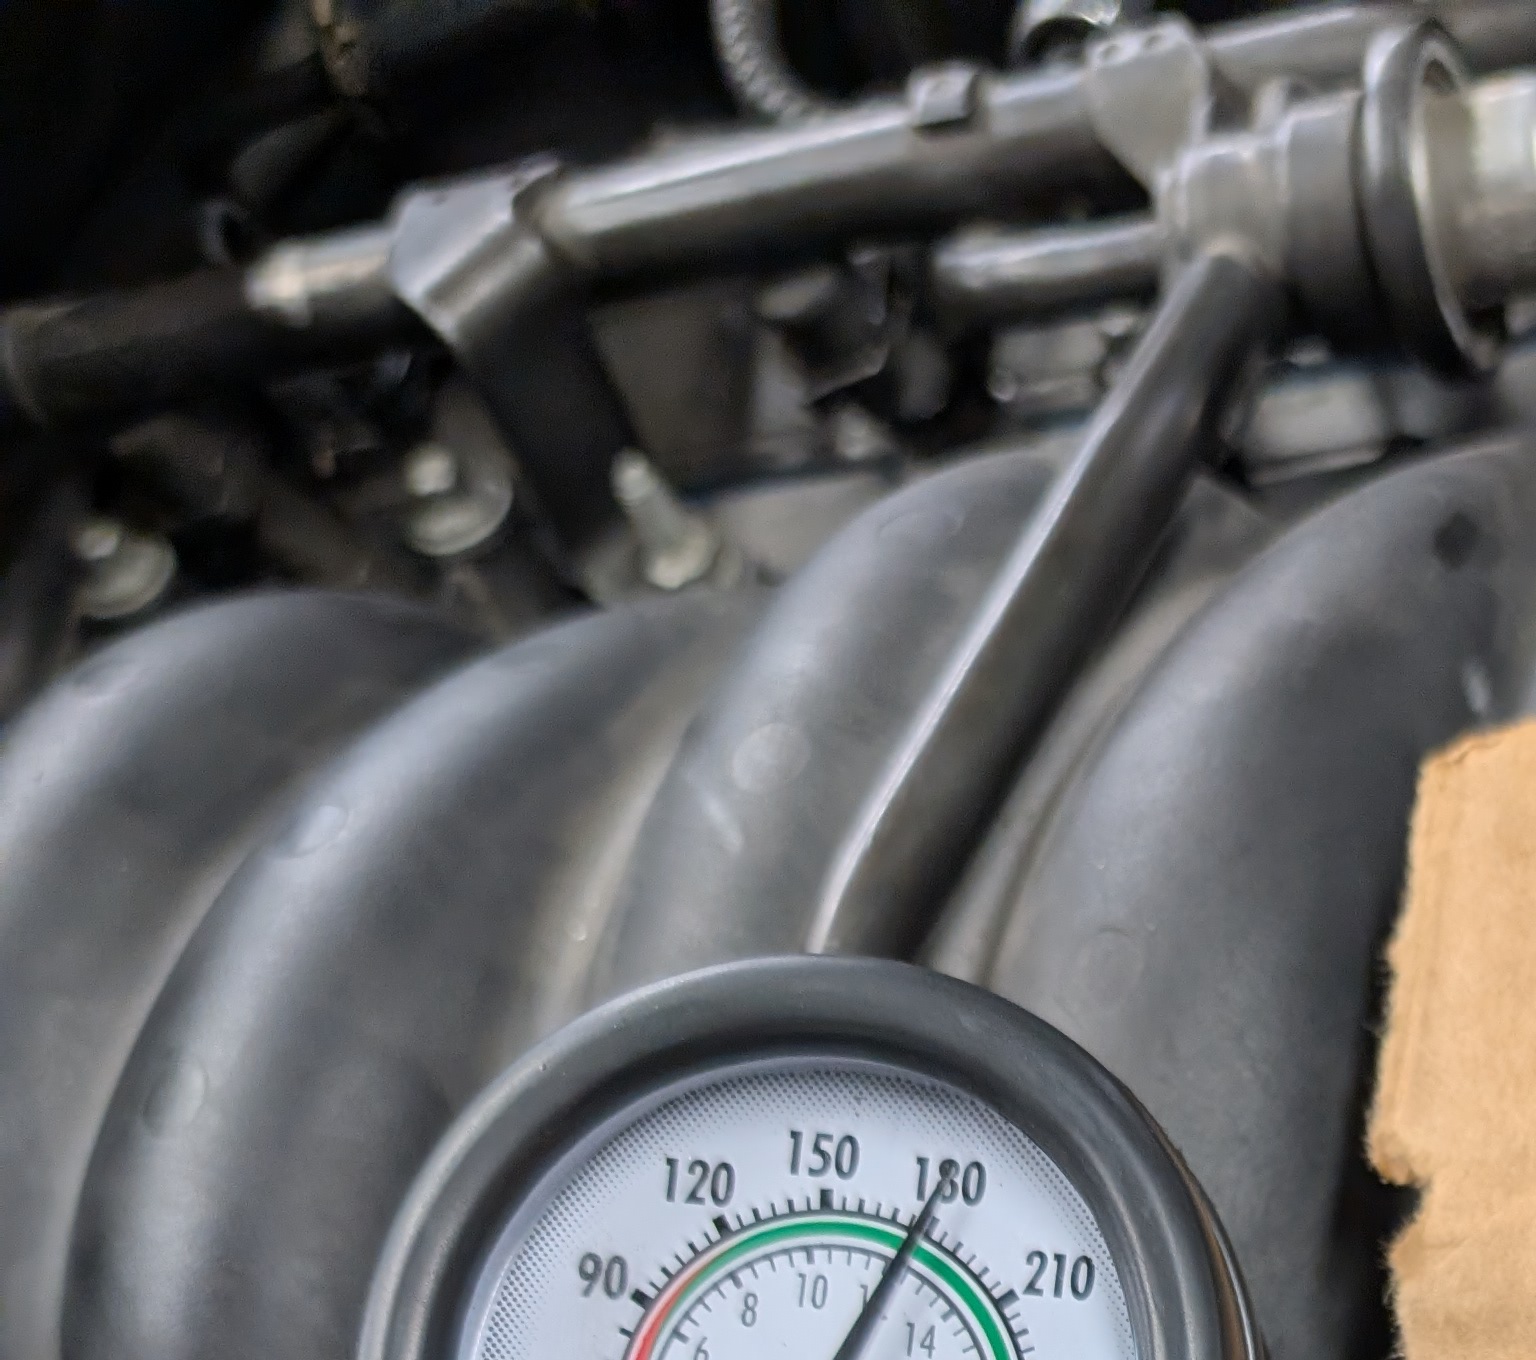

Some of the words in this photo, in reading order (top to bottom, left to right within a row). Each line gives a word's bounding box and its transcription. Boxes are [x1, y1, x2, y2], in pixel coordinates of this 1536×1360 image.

[790, 1130, 860, 1180] 150
[664, 1157, 735, 1206] 120
[916, 1157, 986, 1207] 180
[578, 1252, 627, 1299] 90
[799, 1273, 829, 1309] 10
[1024, 1250, 1095, 1299] 210
[740, 1293, 757, 1327] 8
[904, 1323, 935, 1359] 14
